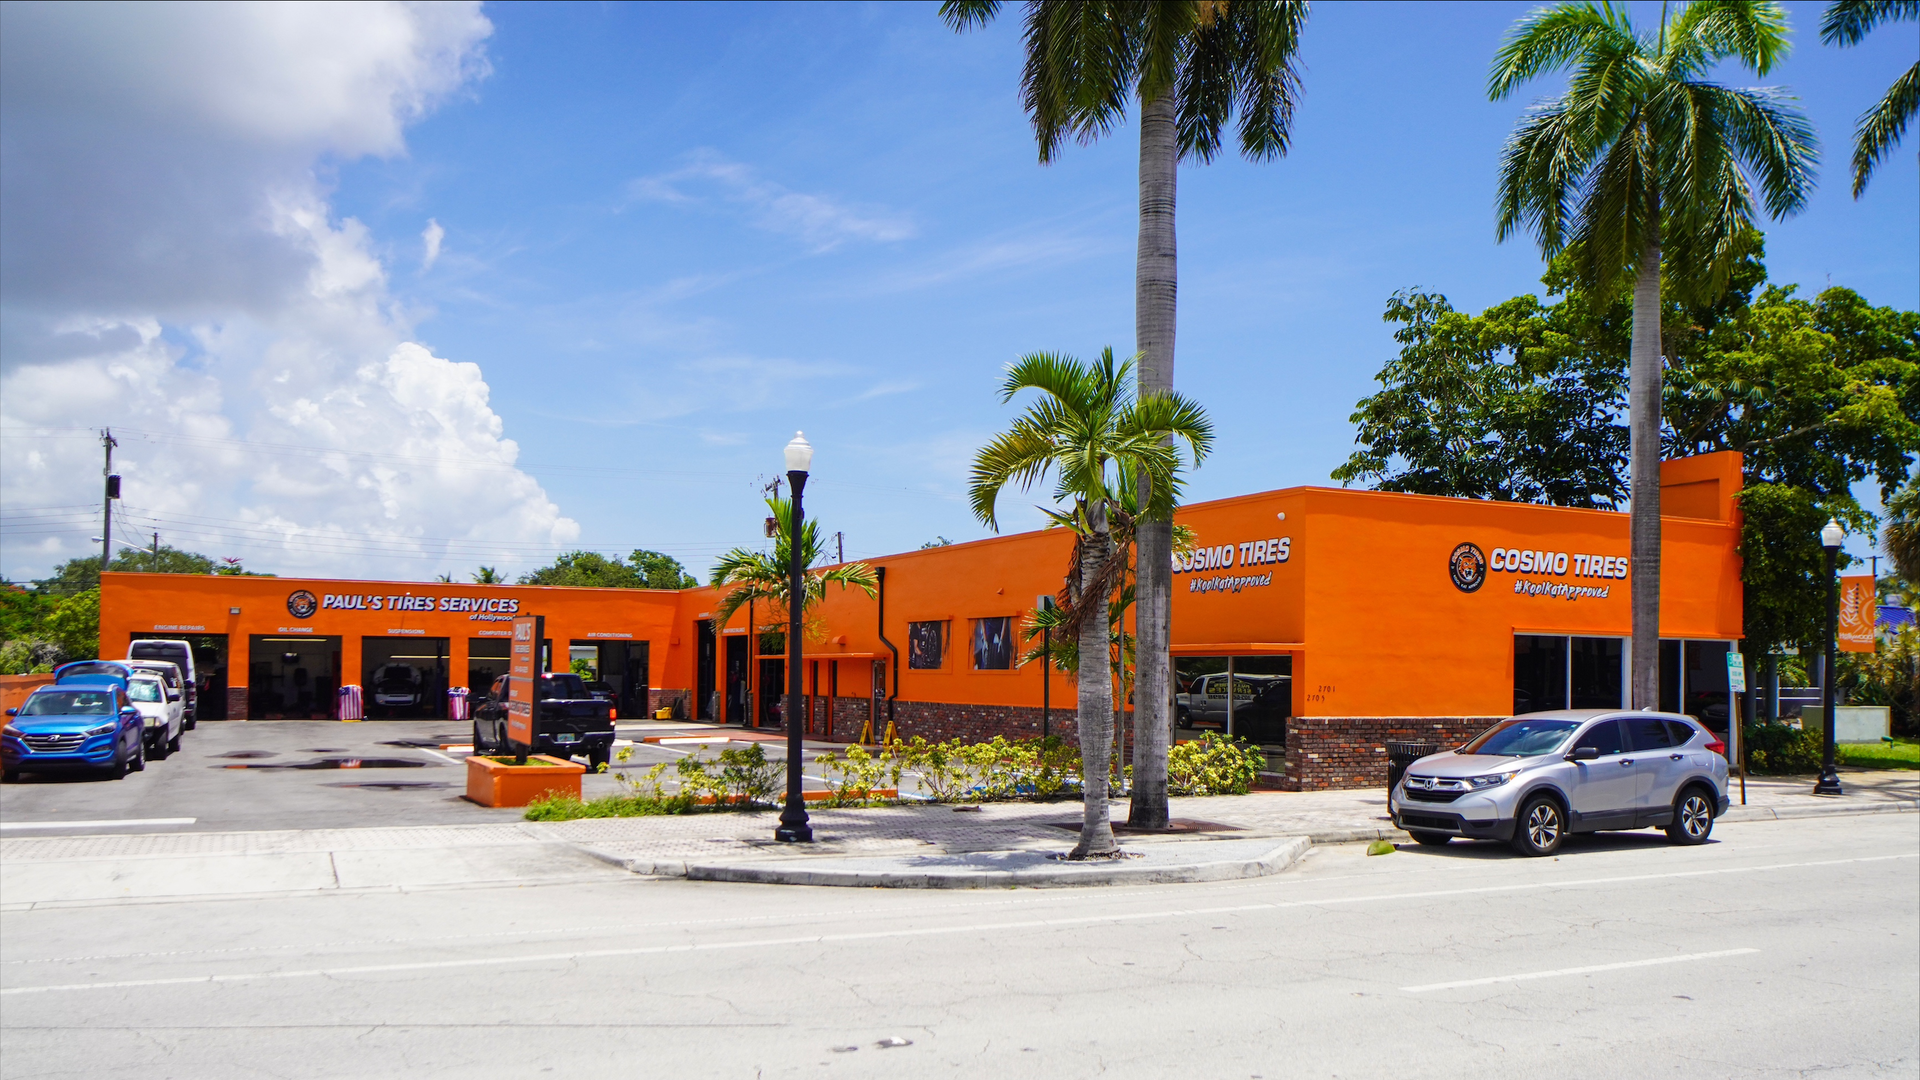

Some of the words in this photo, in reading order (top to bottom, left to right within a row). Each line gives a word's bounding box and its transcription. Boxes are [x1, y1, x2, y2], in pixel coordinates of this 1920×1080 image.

[1239, 536, 1291, 567] TIRES
[1490, 547, 1569, 576] COSMO
[1573, 553, 1628, 580] TIRES
[322, 594, 383, 611] PAUL'S
[386, 595, 435, 611] TIRES
[438, 597, 520, 613] SERVICES
